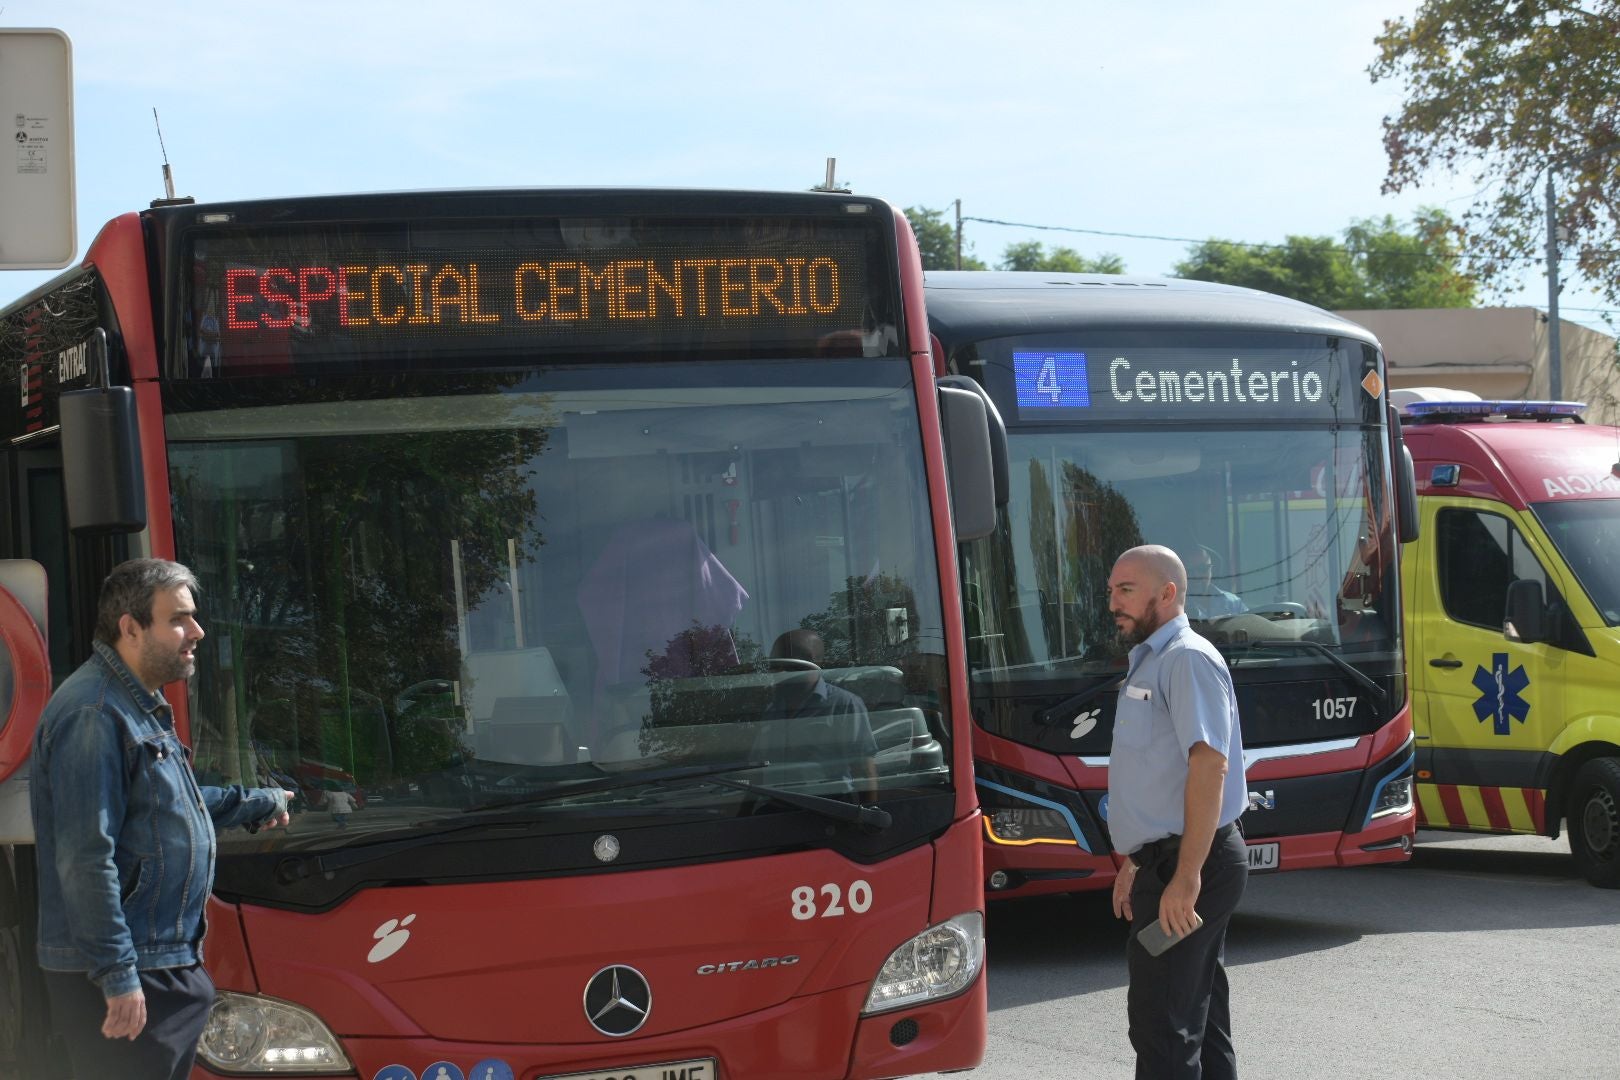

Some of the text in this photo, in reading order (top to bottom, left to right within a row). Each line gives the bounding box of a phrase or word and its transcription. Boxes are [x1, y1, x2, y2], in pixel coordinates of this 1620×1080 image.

[225, 257, 840, 329] ESPECIAL CEMENTERIO
[1036, 356, 1062, 402] 4
[1109, 357, 1323, 402] Cementerio
[1311, 697, 1357, 720] 1057
[791, 879, 873, 921] 820
[696, 954, 800, 976] CITARO
